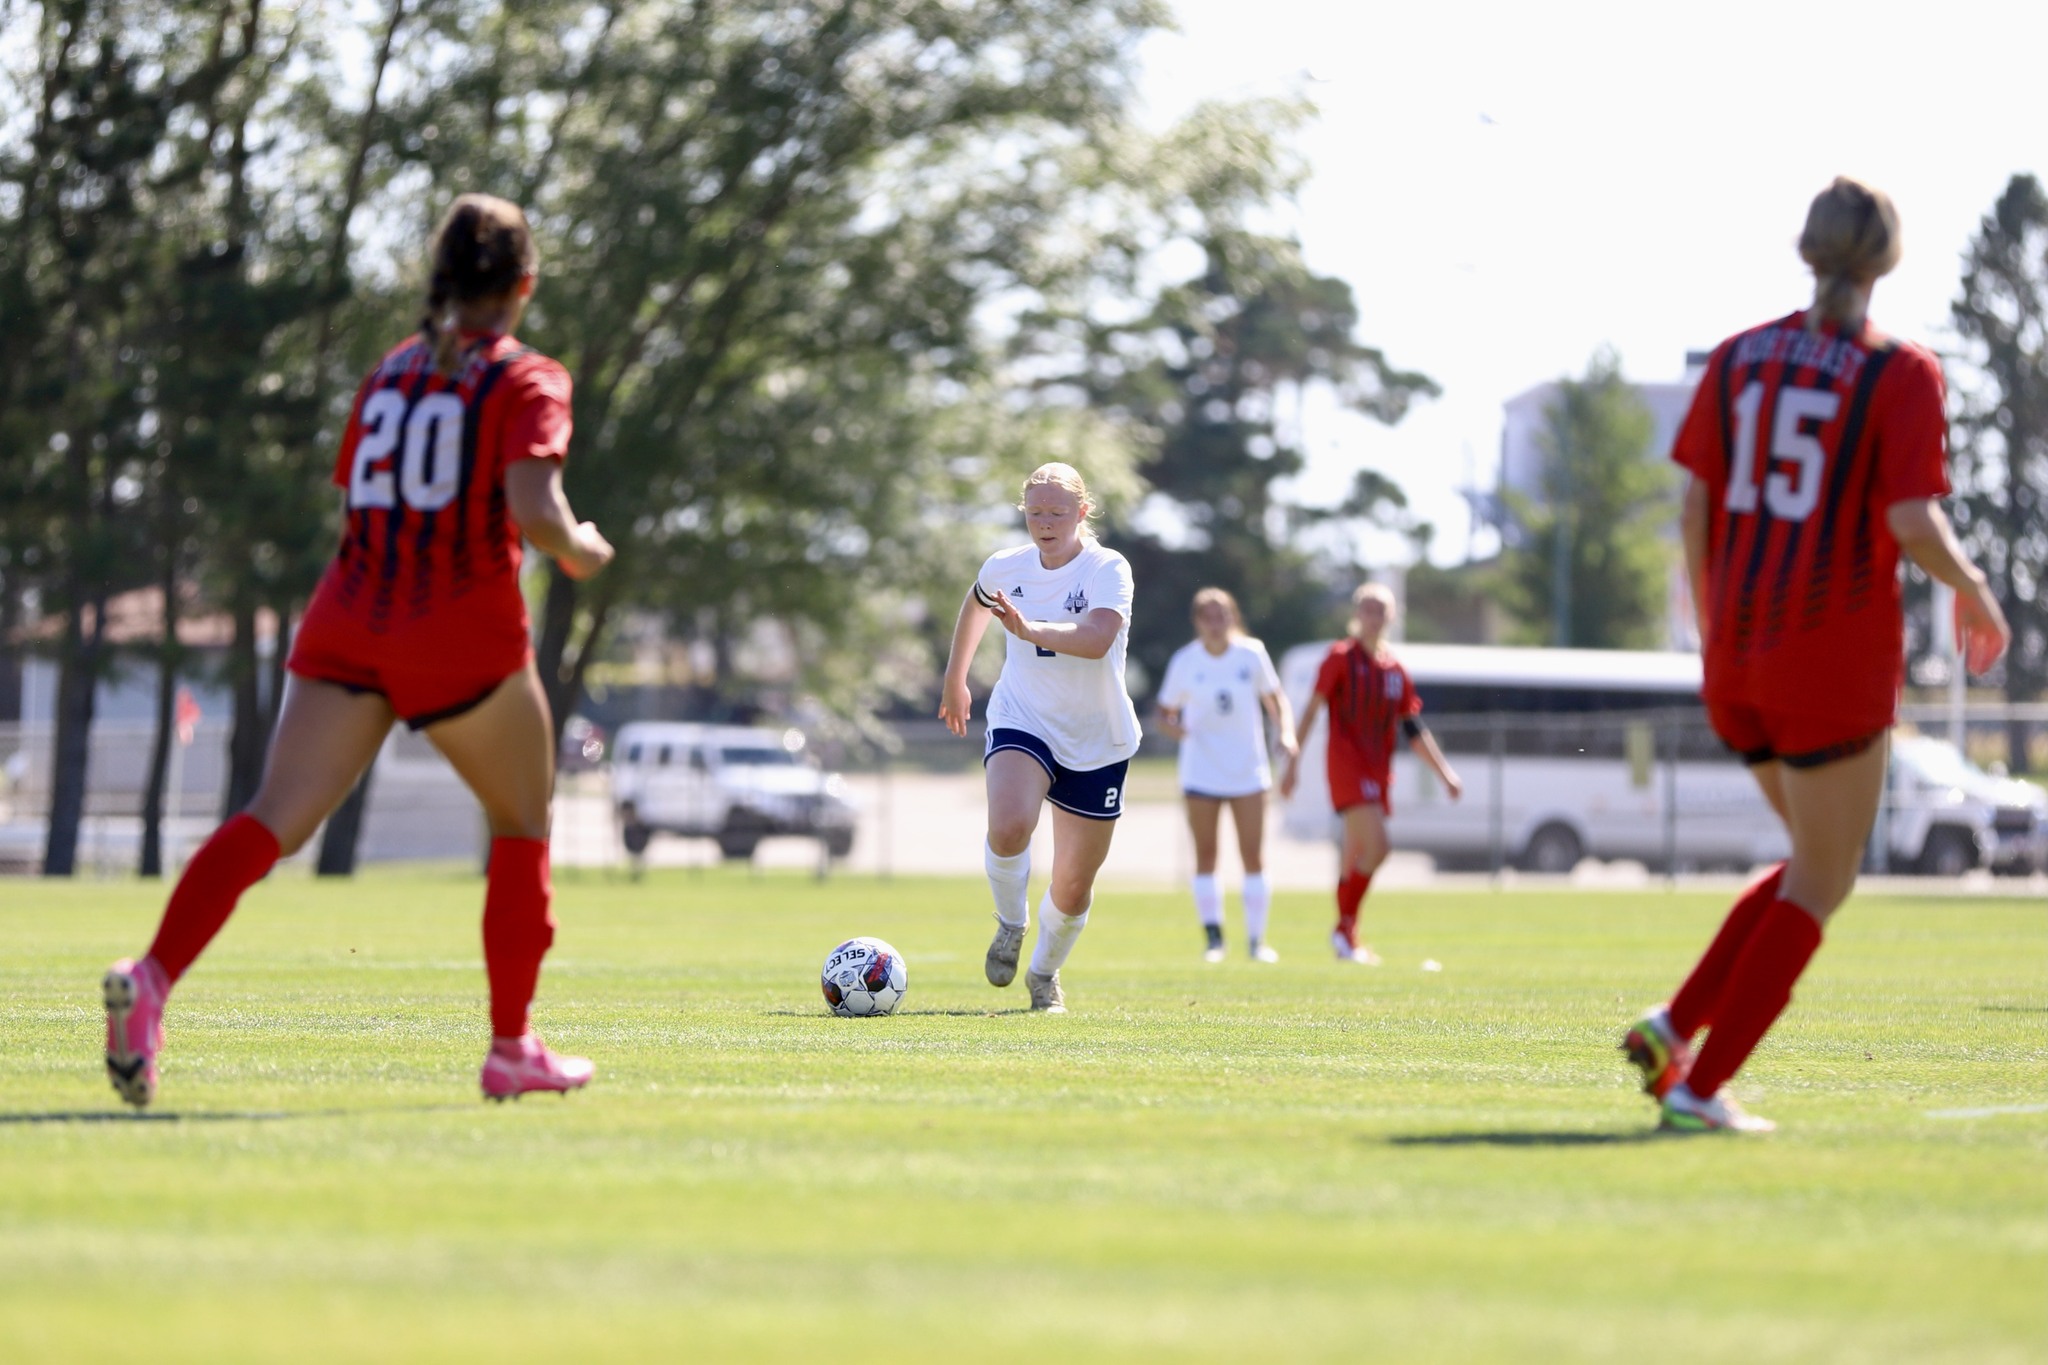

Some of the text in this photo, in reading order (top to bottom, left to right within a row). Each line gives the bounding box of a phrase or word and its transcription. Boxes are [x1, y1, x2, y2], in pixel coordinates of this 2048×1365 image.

[350, 387, 465, 512] 20
[1724, 379, 1841, 521] 15
[1104, 787, 1118, 808] 2
